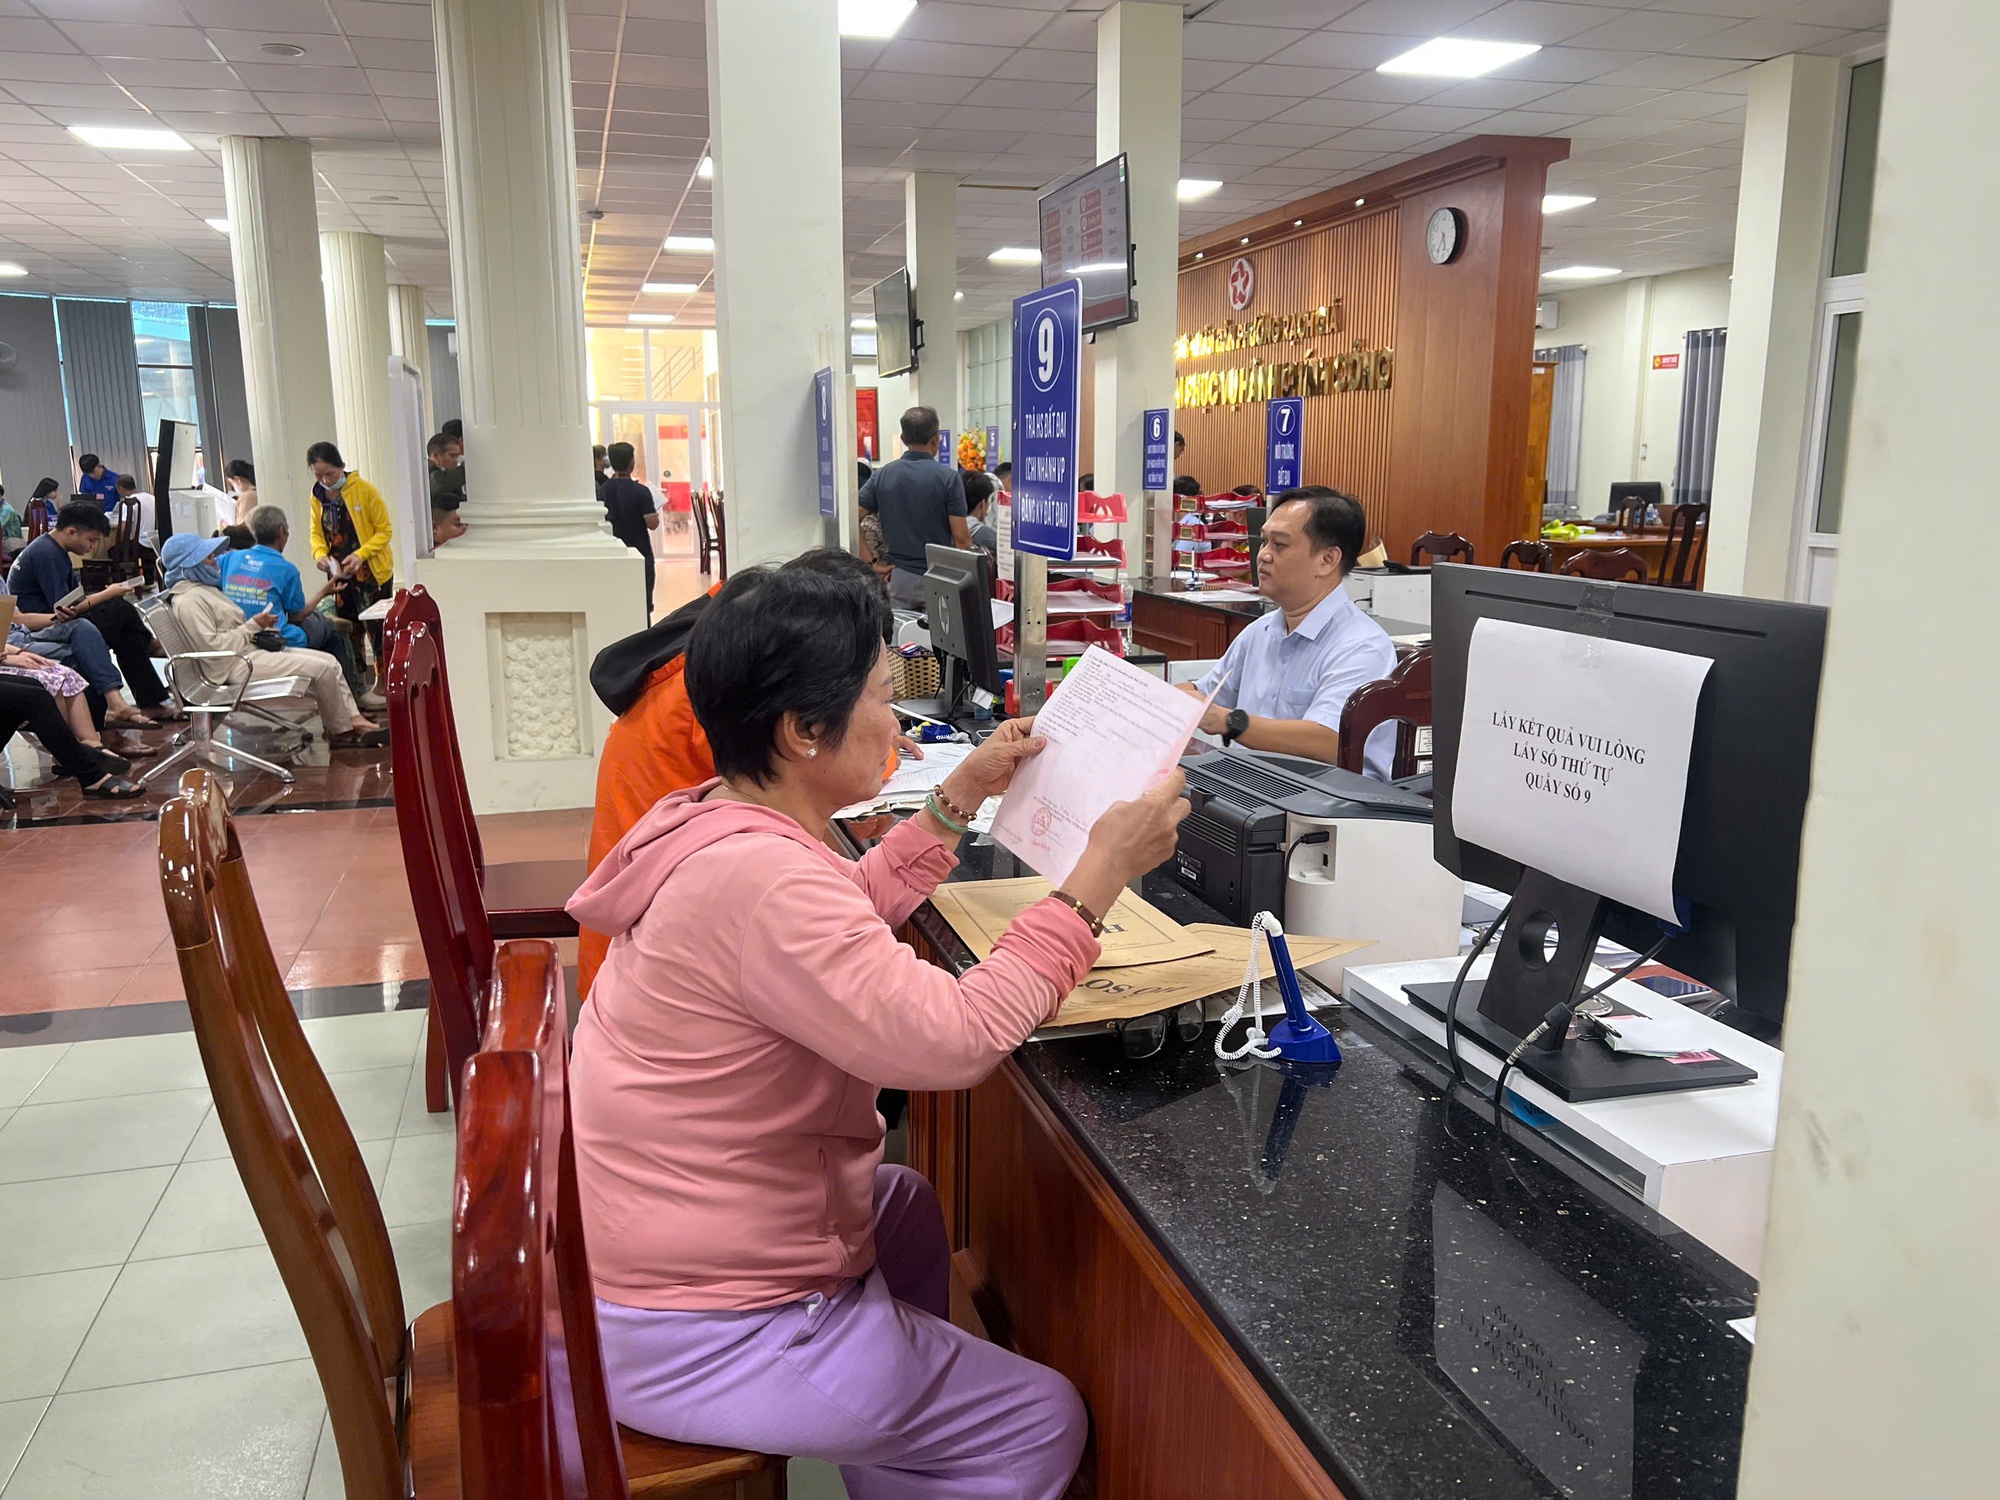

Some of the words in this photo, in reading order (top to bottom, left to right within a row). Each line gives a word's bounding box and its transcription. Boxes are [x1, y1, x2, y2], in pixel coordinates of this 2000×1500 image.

[1282, 310, 1316, 346] RẠCH
[1037, 317, 1054, 383] 9
[1333, 338, 1394, 394] CÔNG
[821, 384, 827, 421] 8
[1280, 408, 1291, 433] 7
[1025, 405, 1036, 439] TRẢ
[1035, 412, 1044, 438] HS
[1044, 403, 1056, 438] ĐẤT
[1056, 411, 1067, 438] ĐAI
[1153, 417, 1160, 438] 6
[1037, 452, 1057, 483] NHÁNH
[1057, 456, 1066, 483] VP
[1021, 493, 1036, 523] ĐĂNG
[1044, 493, 1055, 527] ĐẤT
[1492, 710, 1517, 730] LẤY
[1518, 717, 1545, 738] KẾT
[1546, 726, 1574, 746] QUẢ
[1578, 733, 1603, 753] VUI
[1604, 738, 1646, 765] LÒNG
[1513, 740, 1539, 762] LẤY
[1540, 748, 1558, 768] SỐ
[1561, 755, 1592, 776] THỨ
[1593, 764, 1614, 786] TỰ
[1525, 772, 1562, 795] QUẦY
[1564, 781, 1581, 801] SỐ
[1584, 789, 1592, 804] 9
